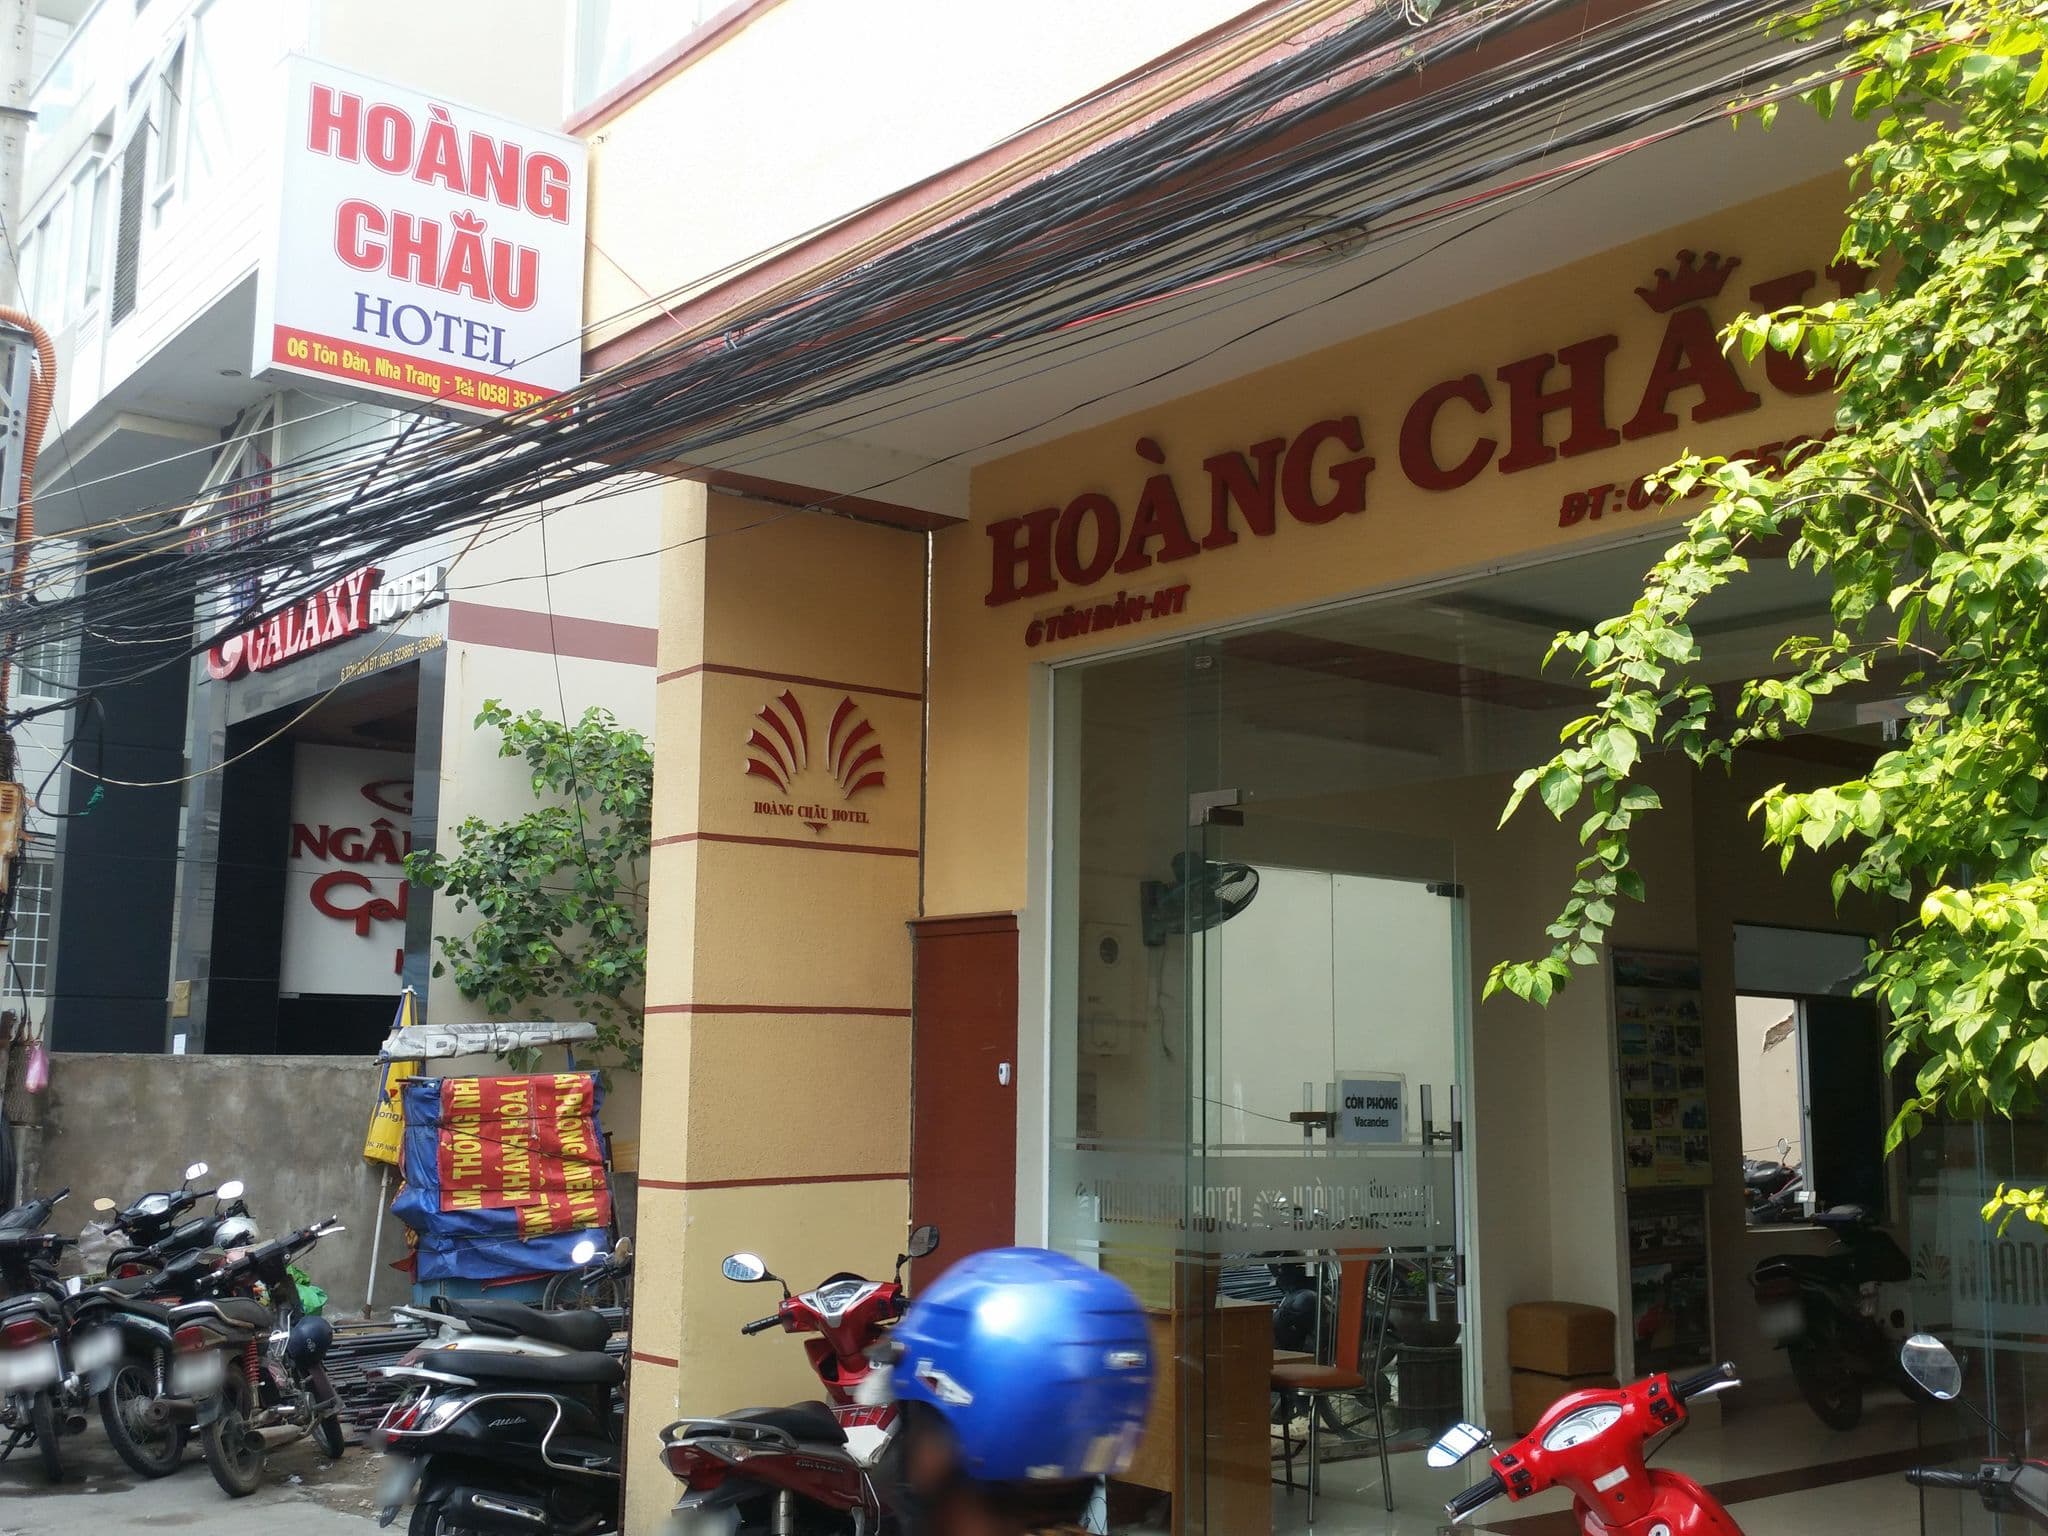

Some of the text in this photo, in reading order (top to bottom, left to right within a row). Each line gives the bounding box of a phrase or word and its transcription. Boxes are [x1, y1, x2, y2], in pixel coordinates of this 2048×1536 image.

[308, 83, 569, 224] HOÀNG
[352, 292, 516, 369] HOTEL
[287, 338, 309, 359] 06
[312, 343, 338, 366] Tôn
[375, 356, 401, 381] Nha
[404, 364, 441, 394] Trang
[985, 415, 1375, 607] HOÀNG
[248, 566, 446, 672] GALAXY HOTEL
[1025, 620, 1045, 647] 6
[754, 801, 794, 816] HOÀNG
[831, 809, 870, 824] HOTEL
[493, 1090, 529, 1130] HÒA
[1354, 1116, 1389, 1128] Vacancies
[495, 1134, 531, 1201] KHÁNH
